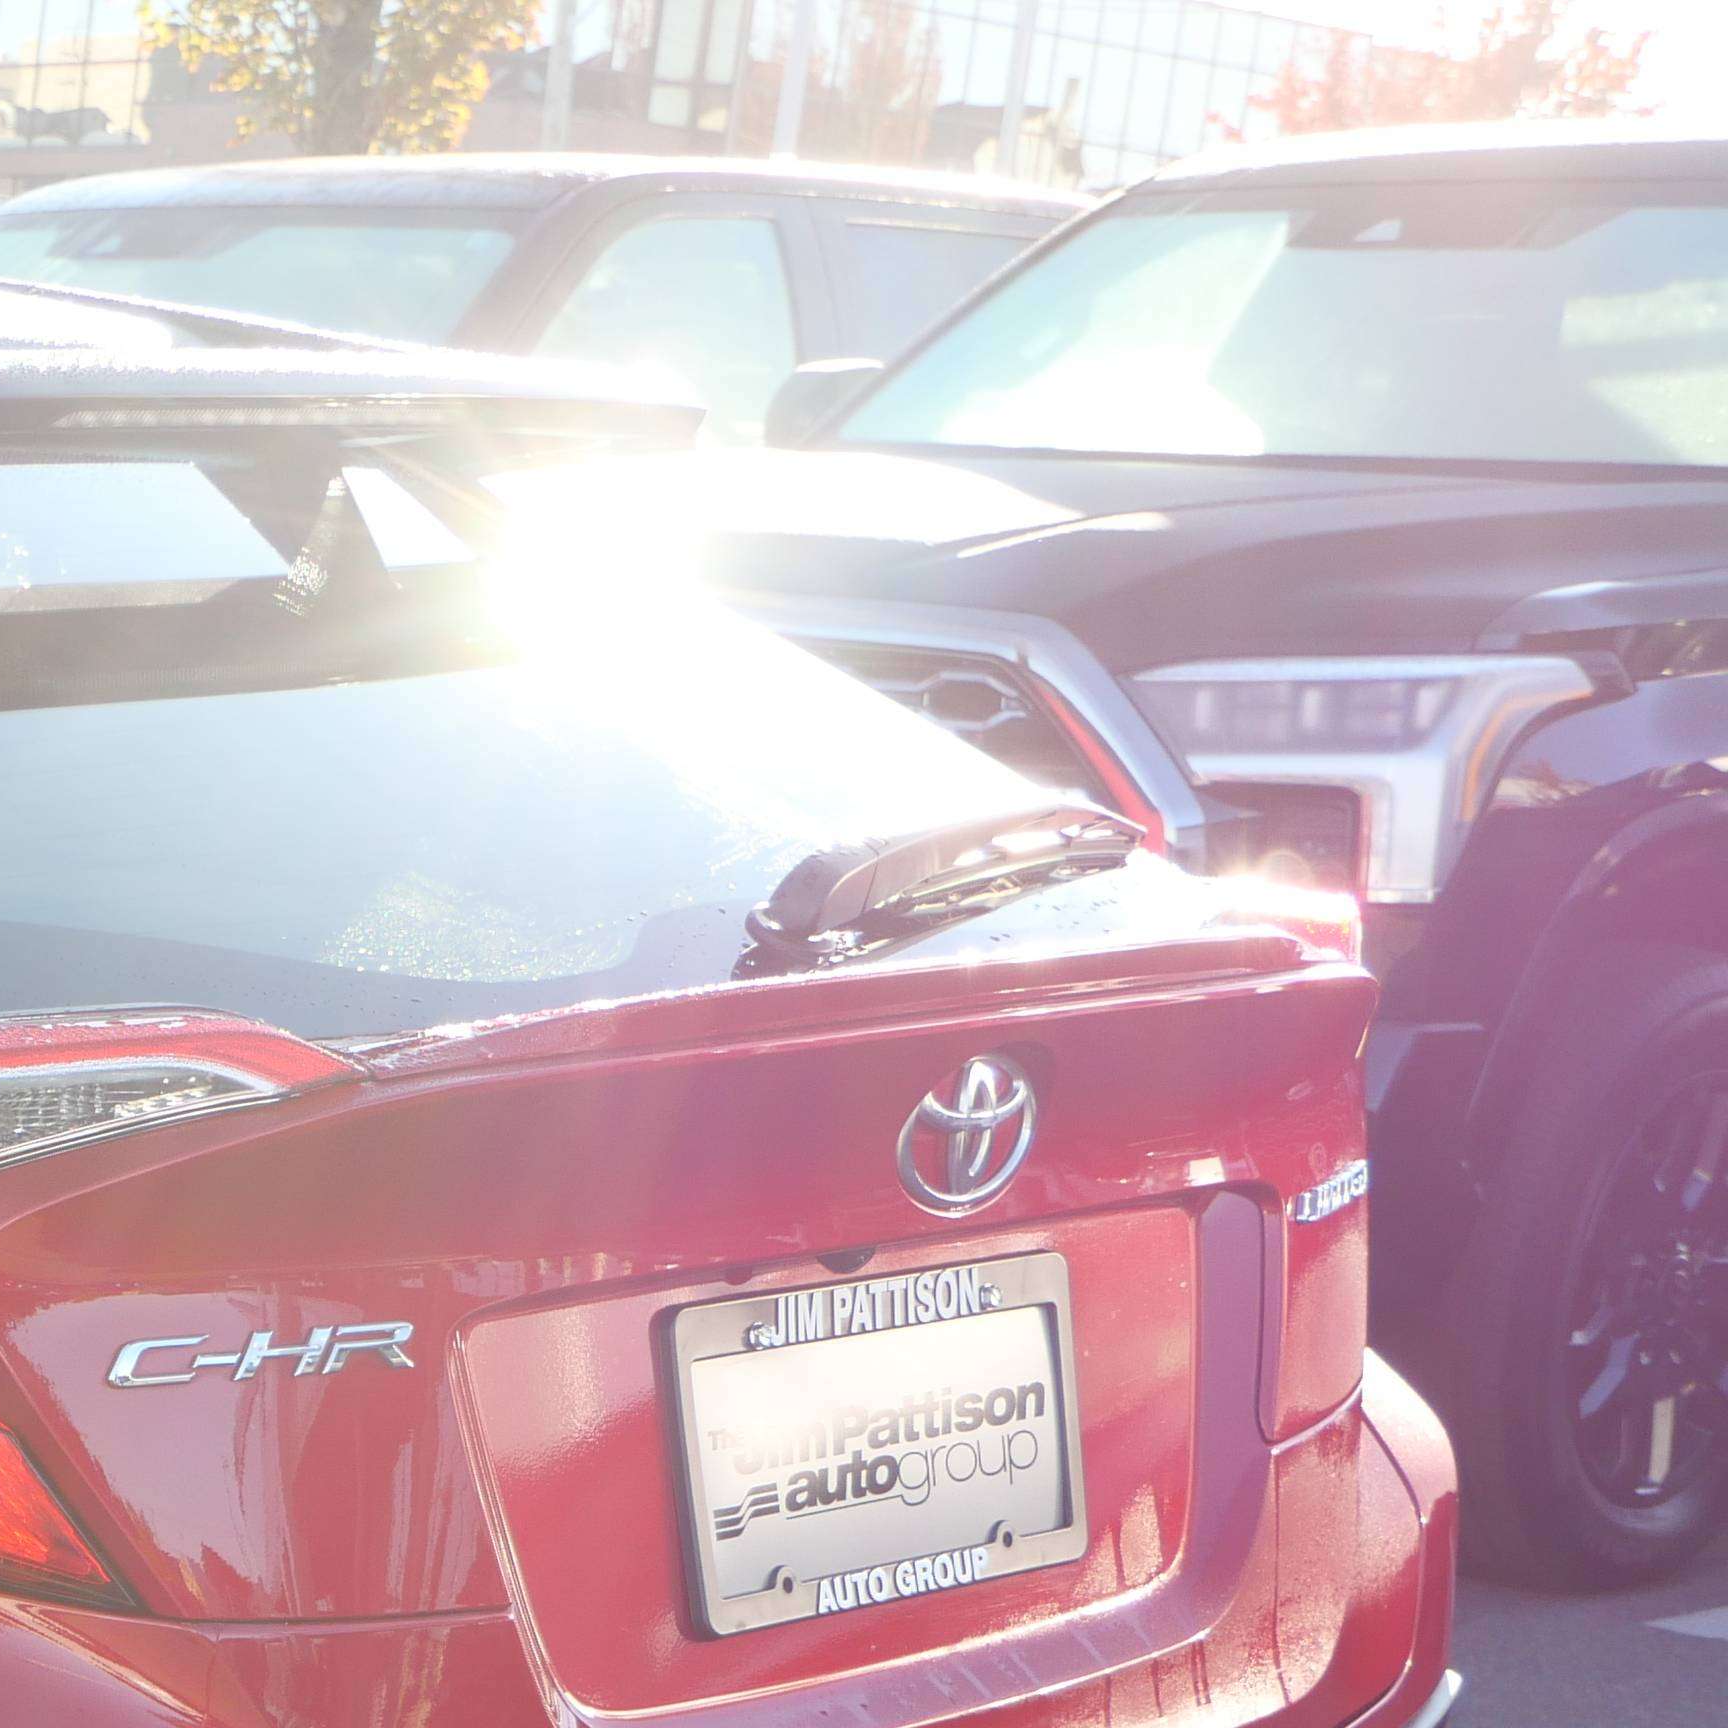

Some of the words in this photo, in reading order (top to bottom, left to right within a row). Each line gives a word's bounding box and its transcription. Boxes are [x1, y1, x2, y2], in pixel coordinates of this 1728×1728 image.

[770, 1293, 824, 1347] JIM
[832, 1268, 980, 1337] PATTISON
[107, 1320, 415, 1389] C-HR
[831, 1381, 1046, 1454] Pattison
[818, 1567, 887, 1615] AUTO
[895, 1546, 989, 1598] GROUP
